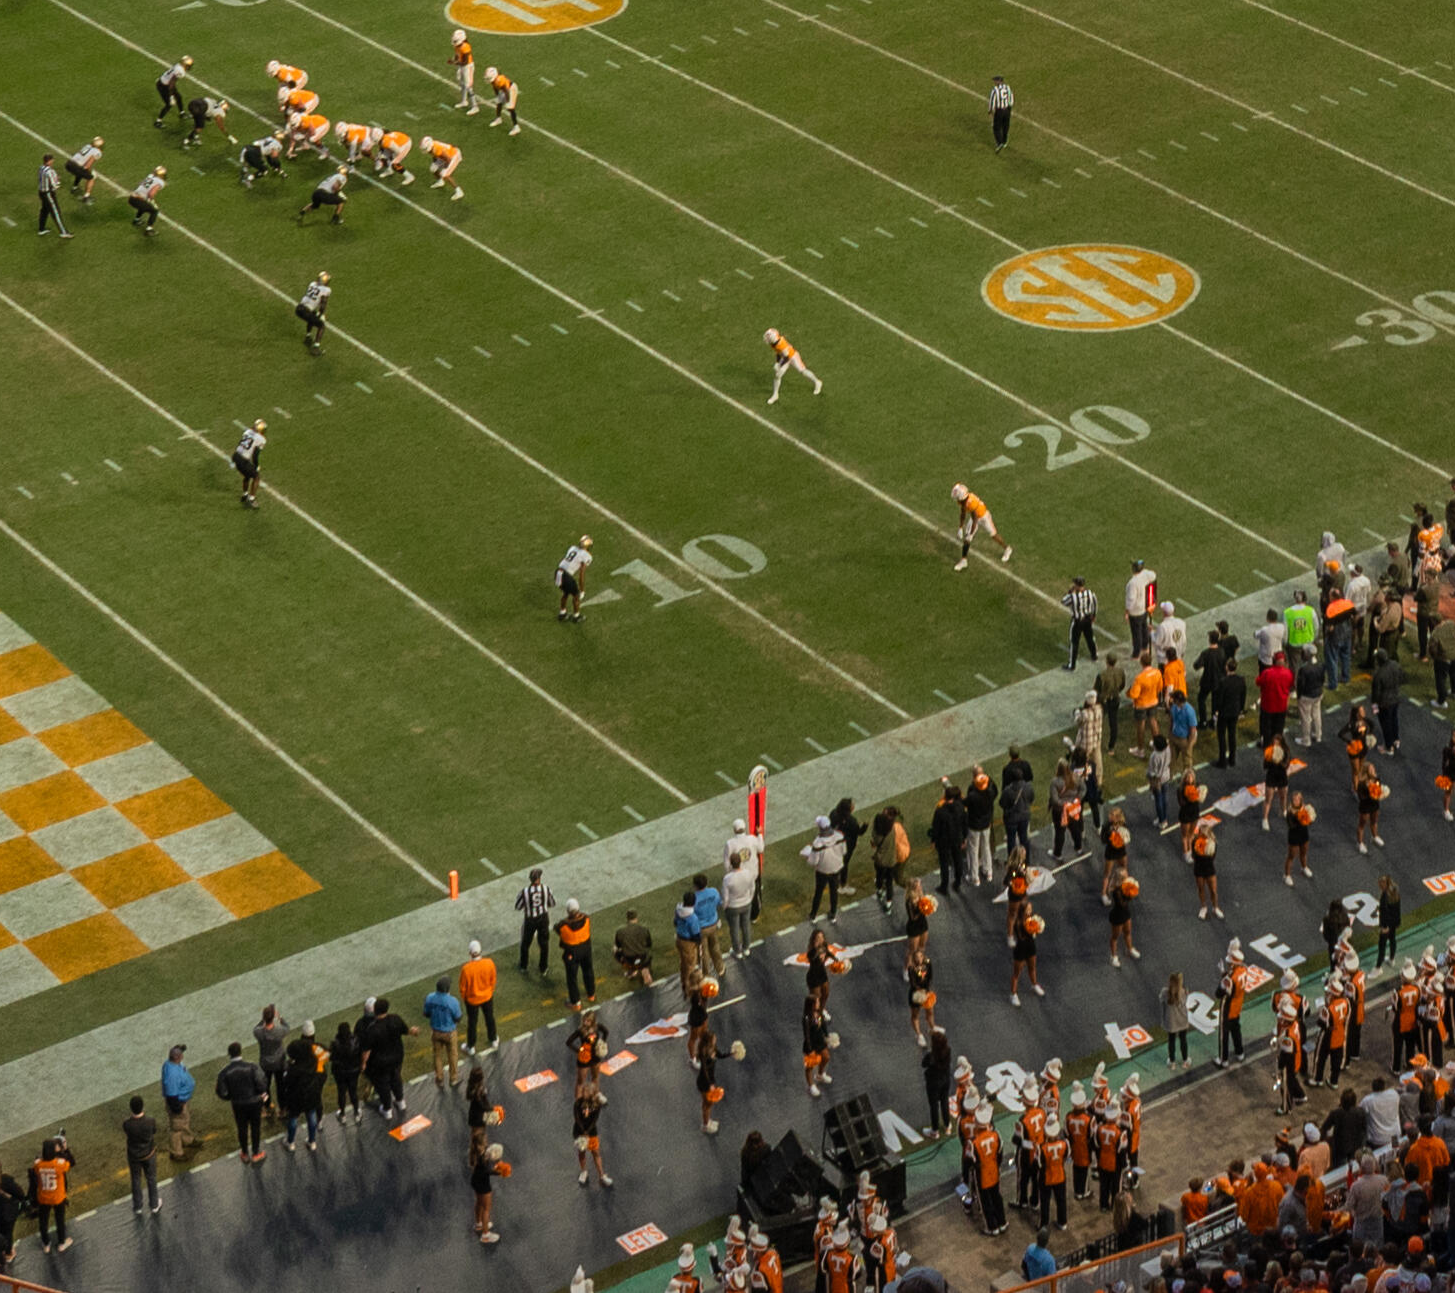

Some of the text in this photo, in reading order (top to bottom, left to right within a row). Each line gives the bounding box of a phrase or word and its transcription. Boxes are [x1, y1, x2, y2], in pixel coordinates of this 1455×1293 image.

[1002, 251, 1177, 323] SEC
[1004, 404, 1151, 472] 20
[610, 533, 767, 608] 10
